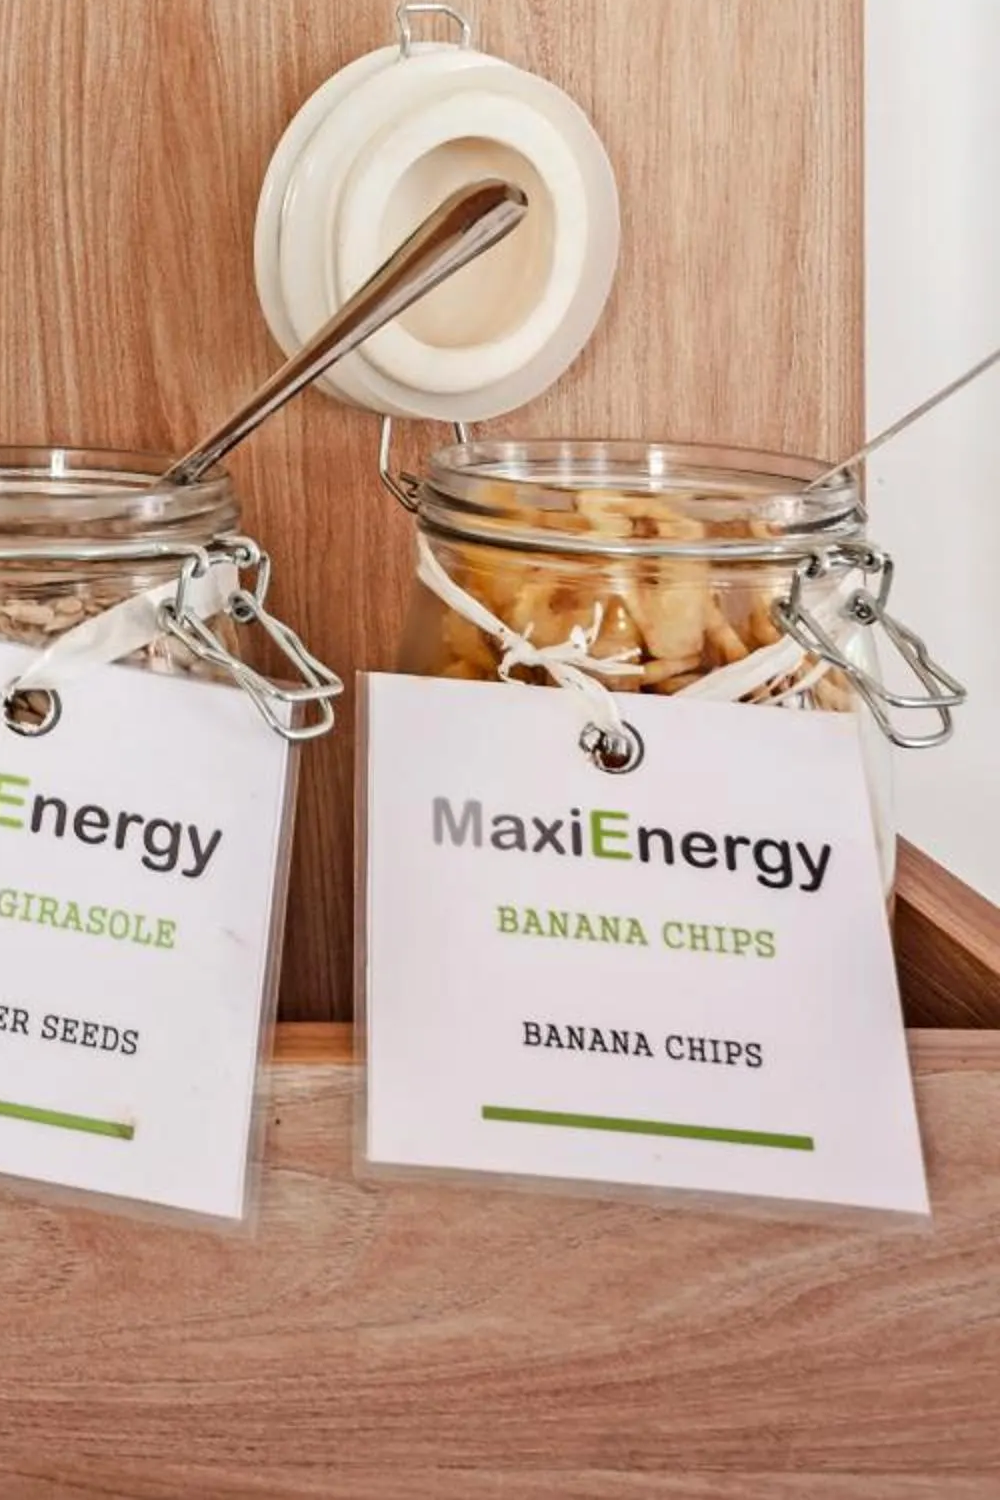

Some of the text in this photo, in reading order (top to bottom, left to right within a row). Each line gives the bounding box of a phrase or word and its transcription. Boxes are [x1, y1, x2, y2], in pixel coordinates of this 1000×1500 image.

[431, 796, 831, 893] MaxiEnergy
[497, 906, 777, 959] BANANA CHIPS
[41, 1014, 140, 1056] SEEDS
[522, 1020, 763, 1068] BANANA CHIPS
